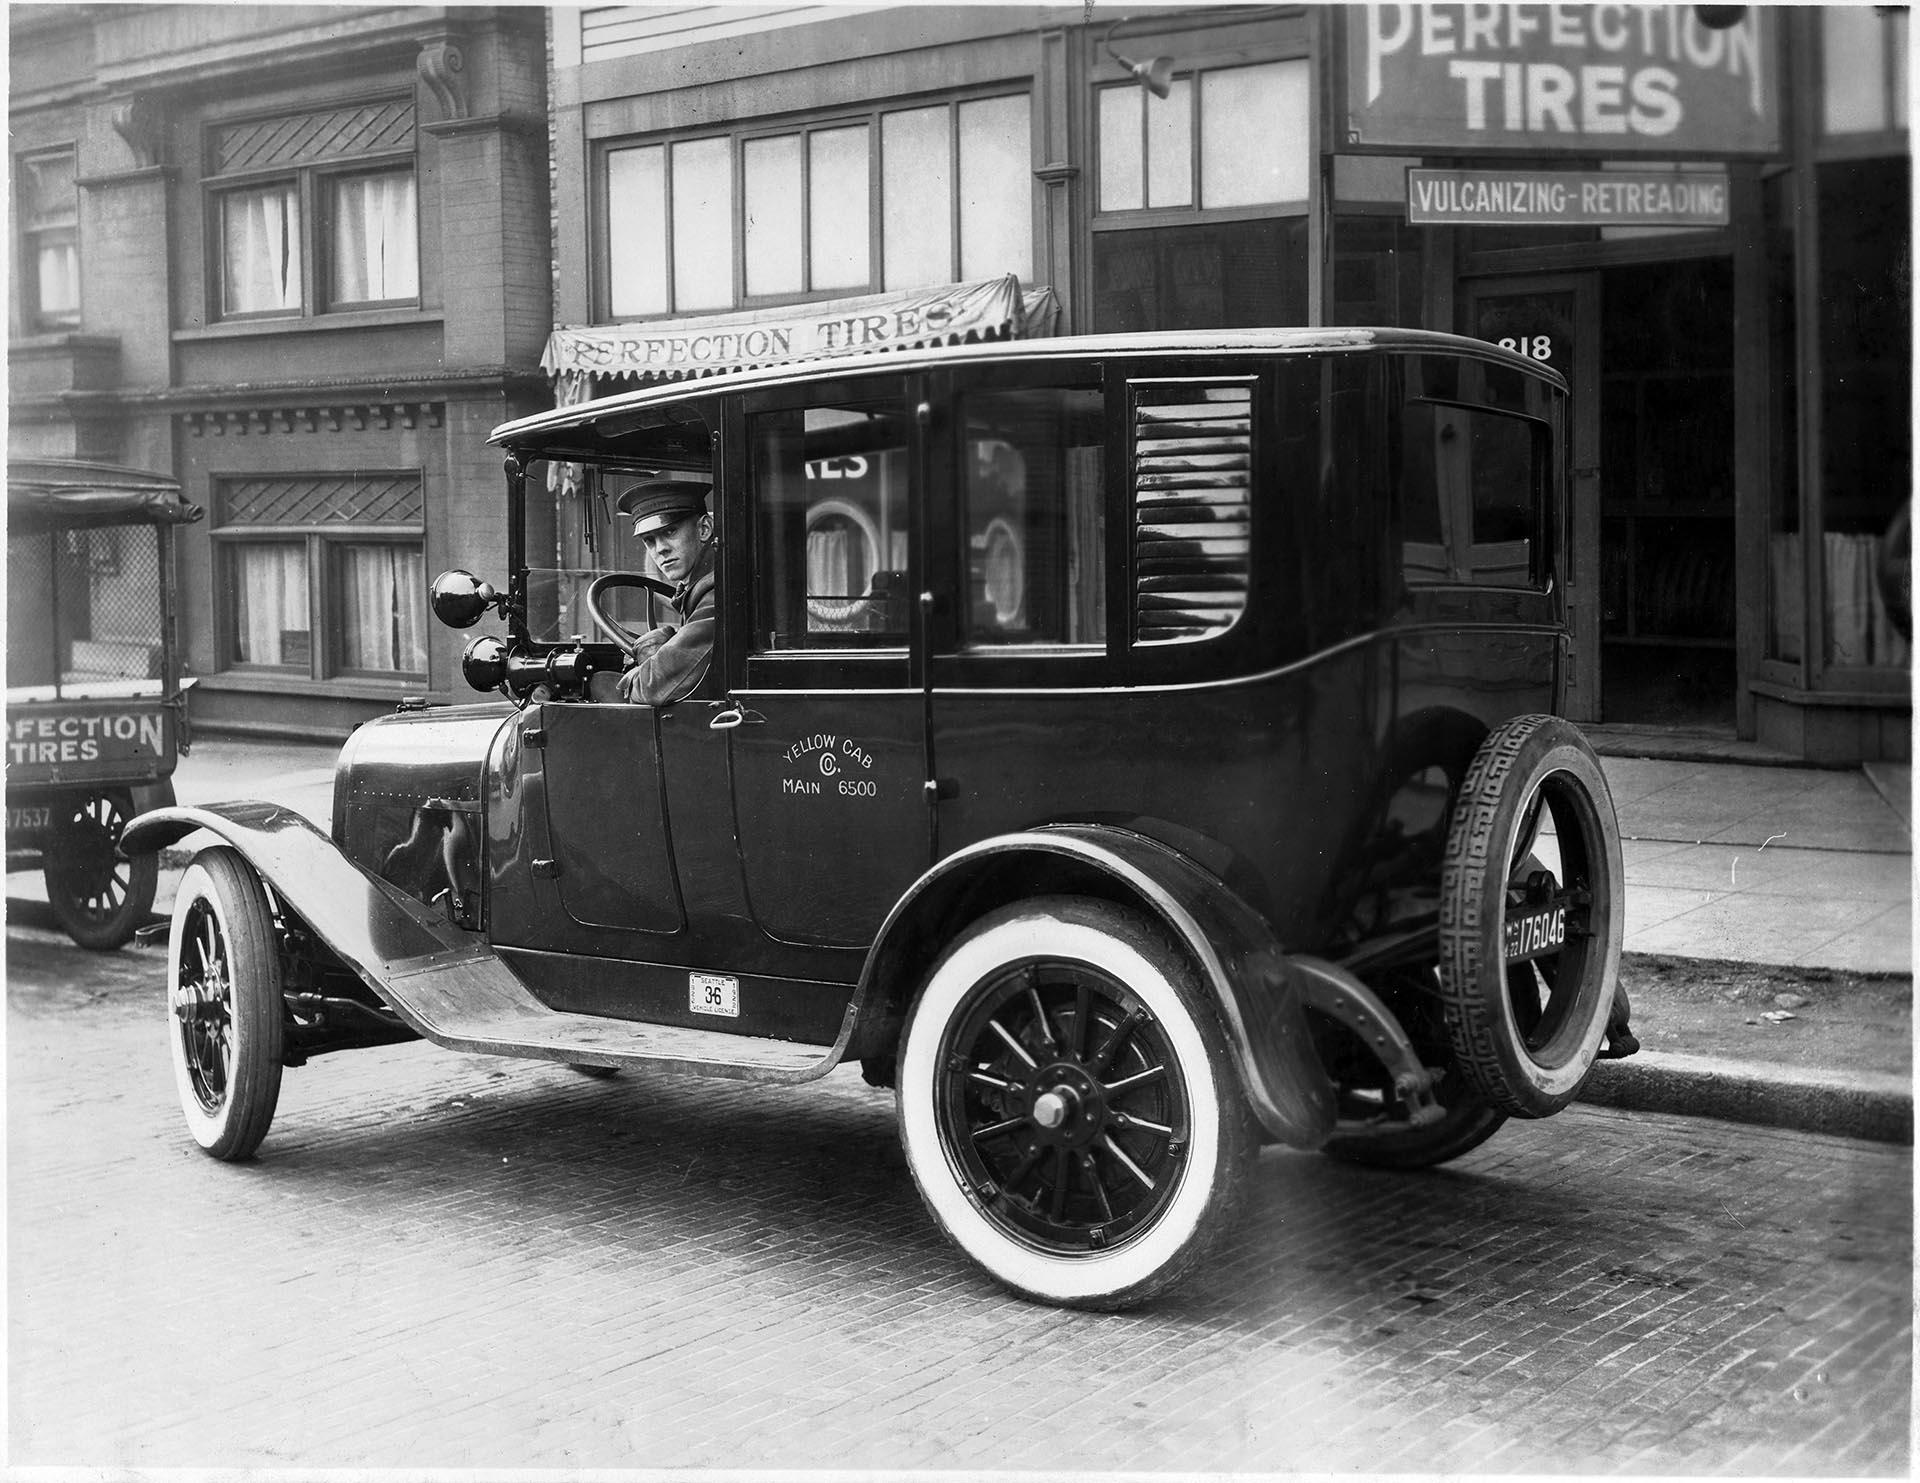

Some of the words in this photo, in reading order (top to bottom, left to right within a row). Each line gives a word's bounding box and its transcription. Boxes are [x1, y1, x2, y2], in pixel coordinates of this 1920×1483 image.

[1367, 5, 1764, 120] PERFECTION
[1449, 60, 1683, 136] TIRES
[572, 327, 793, 366] PERFECTION
[816, 301, 953, 349] TIRES
[9, 739, 99, 764] TIRES
[782, 734, 836, 764] YELLOW
[842, 739, 873, 769] CAB
[782, 778, 820, 794] MAIN
[838, 780, 876, 797] 6500
[1519, 908, 1565, 955] 176046
[705, 985, 722, 1005] 36
